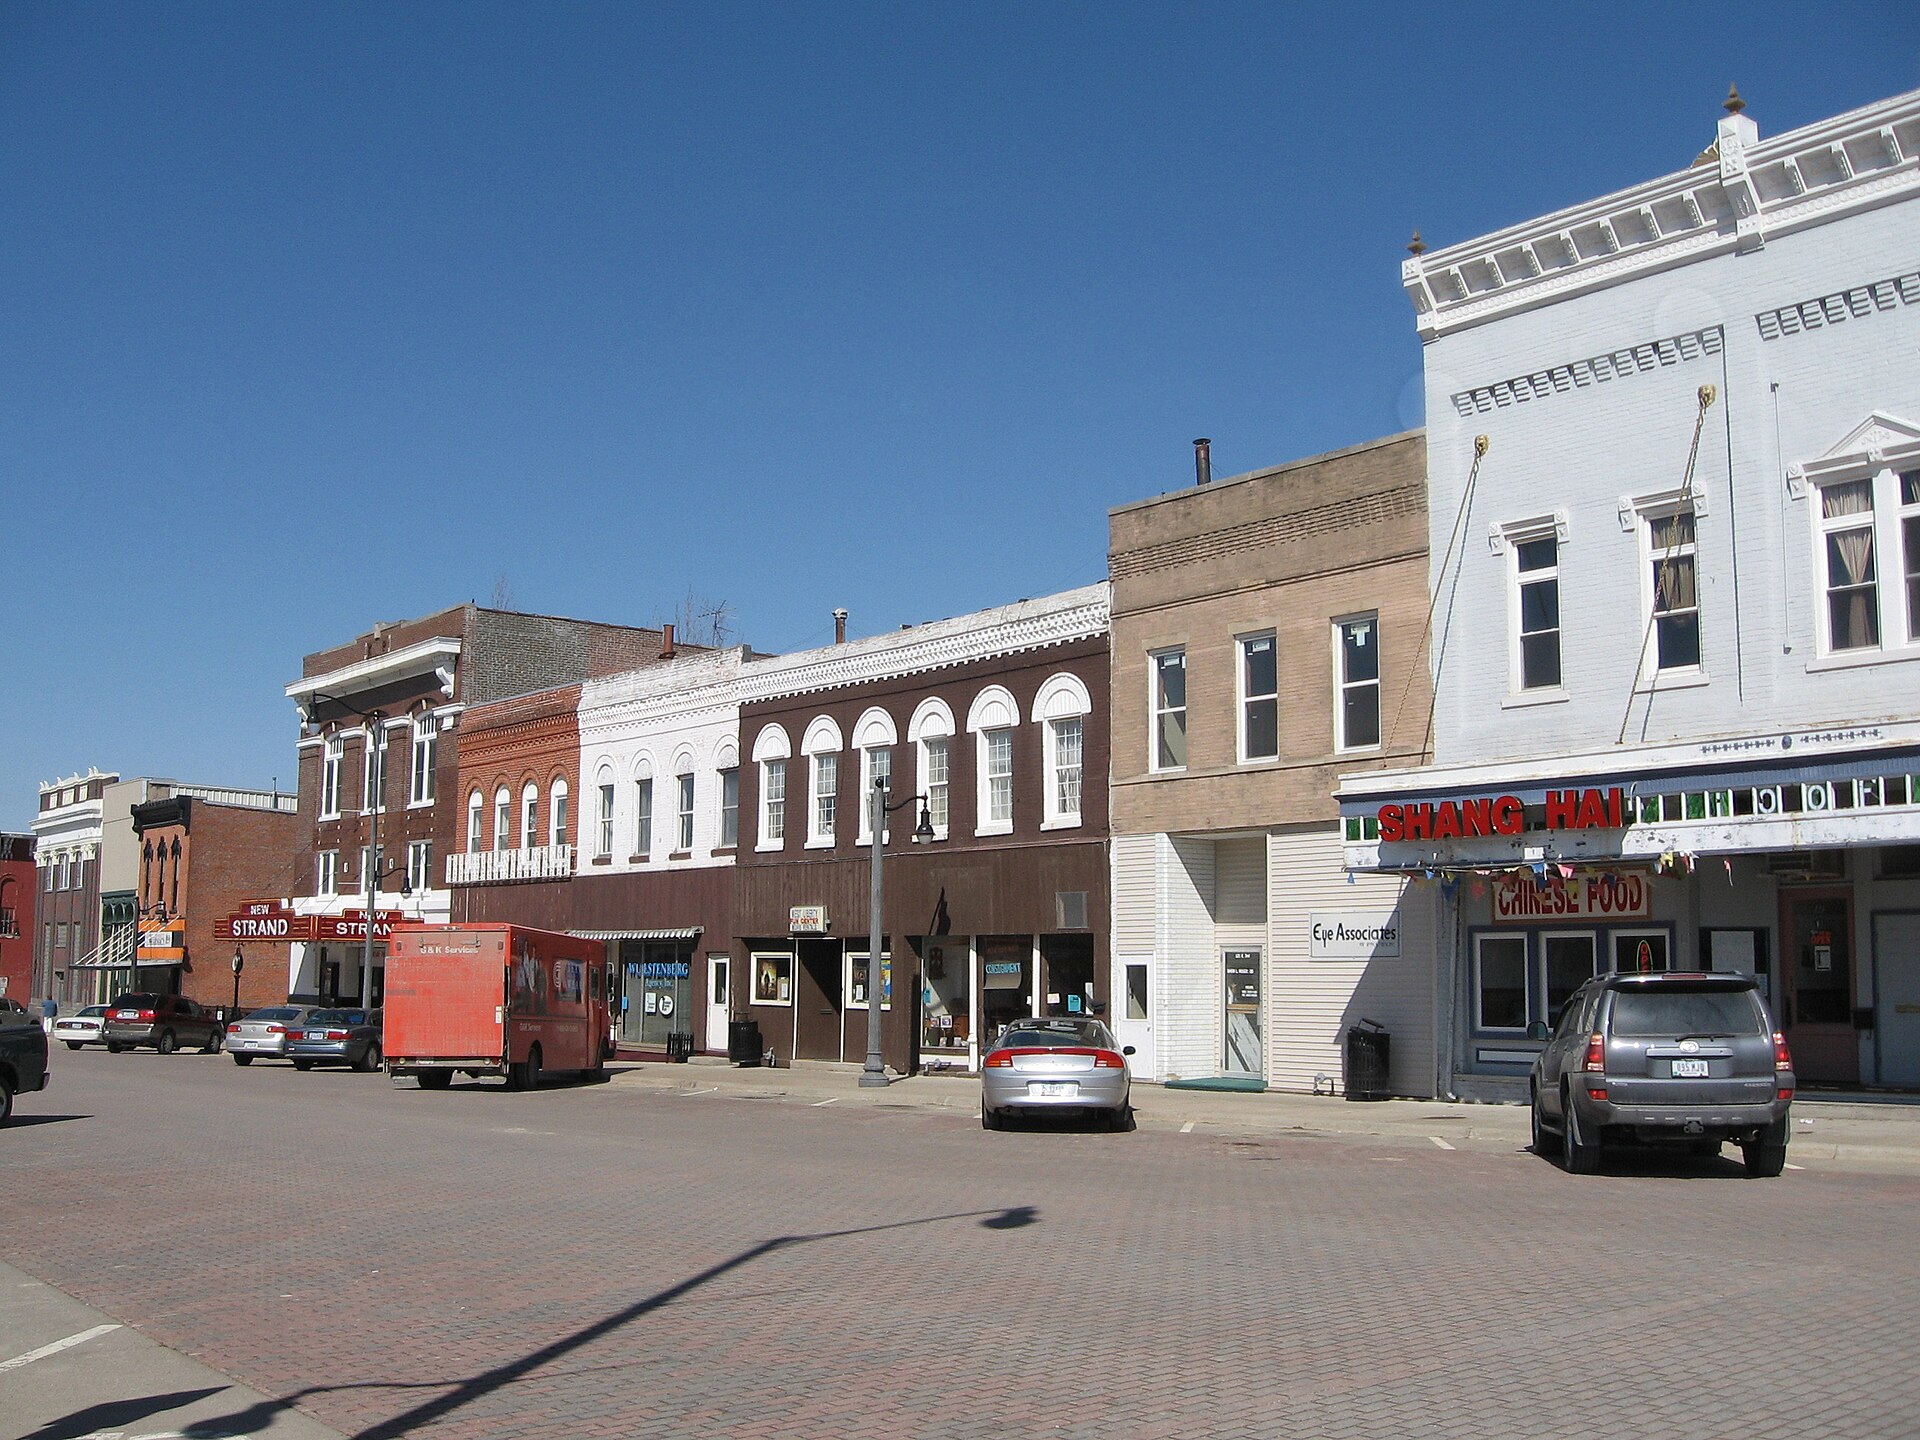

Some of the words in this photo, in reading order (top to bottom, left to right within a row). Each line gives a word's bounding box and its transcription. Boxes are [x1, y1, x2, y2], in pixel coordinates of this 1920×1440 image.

[1377, 795, 1524, 842] SHANG
[1546, 787, 1624, 830] HAI
[1499, 878, 1579, 915] CHINESE
[1587, 875, 1641, 913] FOOD
[250, 904, 270, 915] NEW
[359, 911, 388, 920] NW
[232, 919, 288, 936] STRAND
[336, 922, 395, 935] STRAN
[1313, 922, 1334, 948] Eye
[1336, 922, 1396, 941] Associates
[435, 946, 442, 954] K
[445, 945, 479, 954] Services
